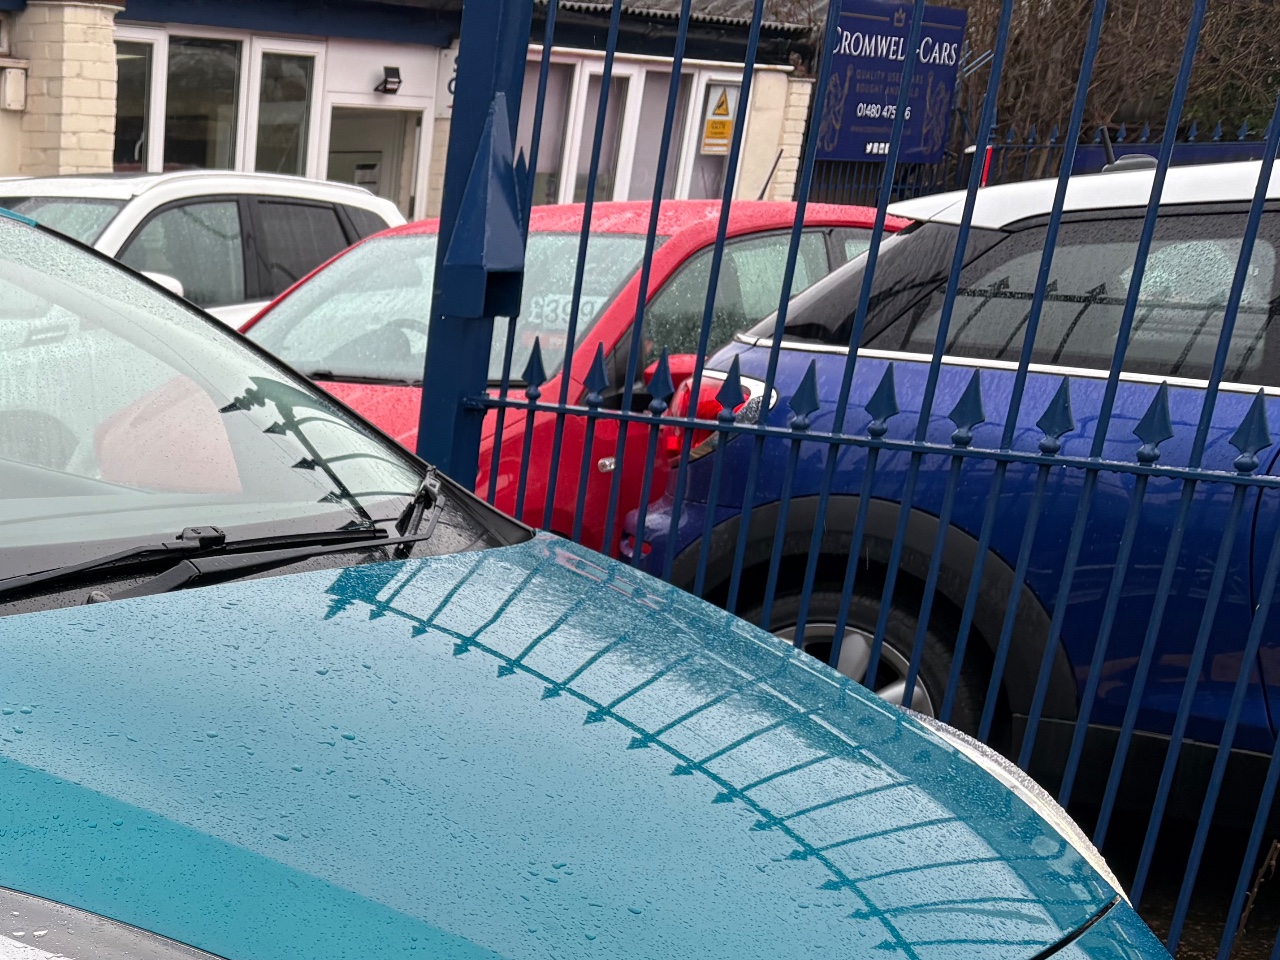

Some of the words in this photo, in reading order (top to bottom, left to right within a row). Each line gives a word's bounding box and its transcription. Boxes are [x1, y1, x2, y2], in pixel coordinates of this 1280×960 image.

[833, 26, 958, 66] ROMWEL-CARS
[856, 103, 881, 118] 01480
[881, 105, 911, 120] 4756
